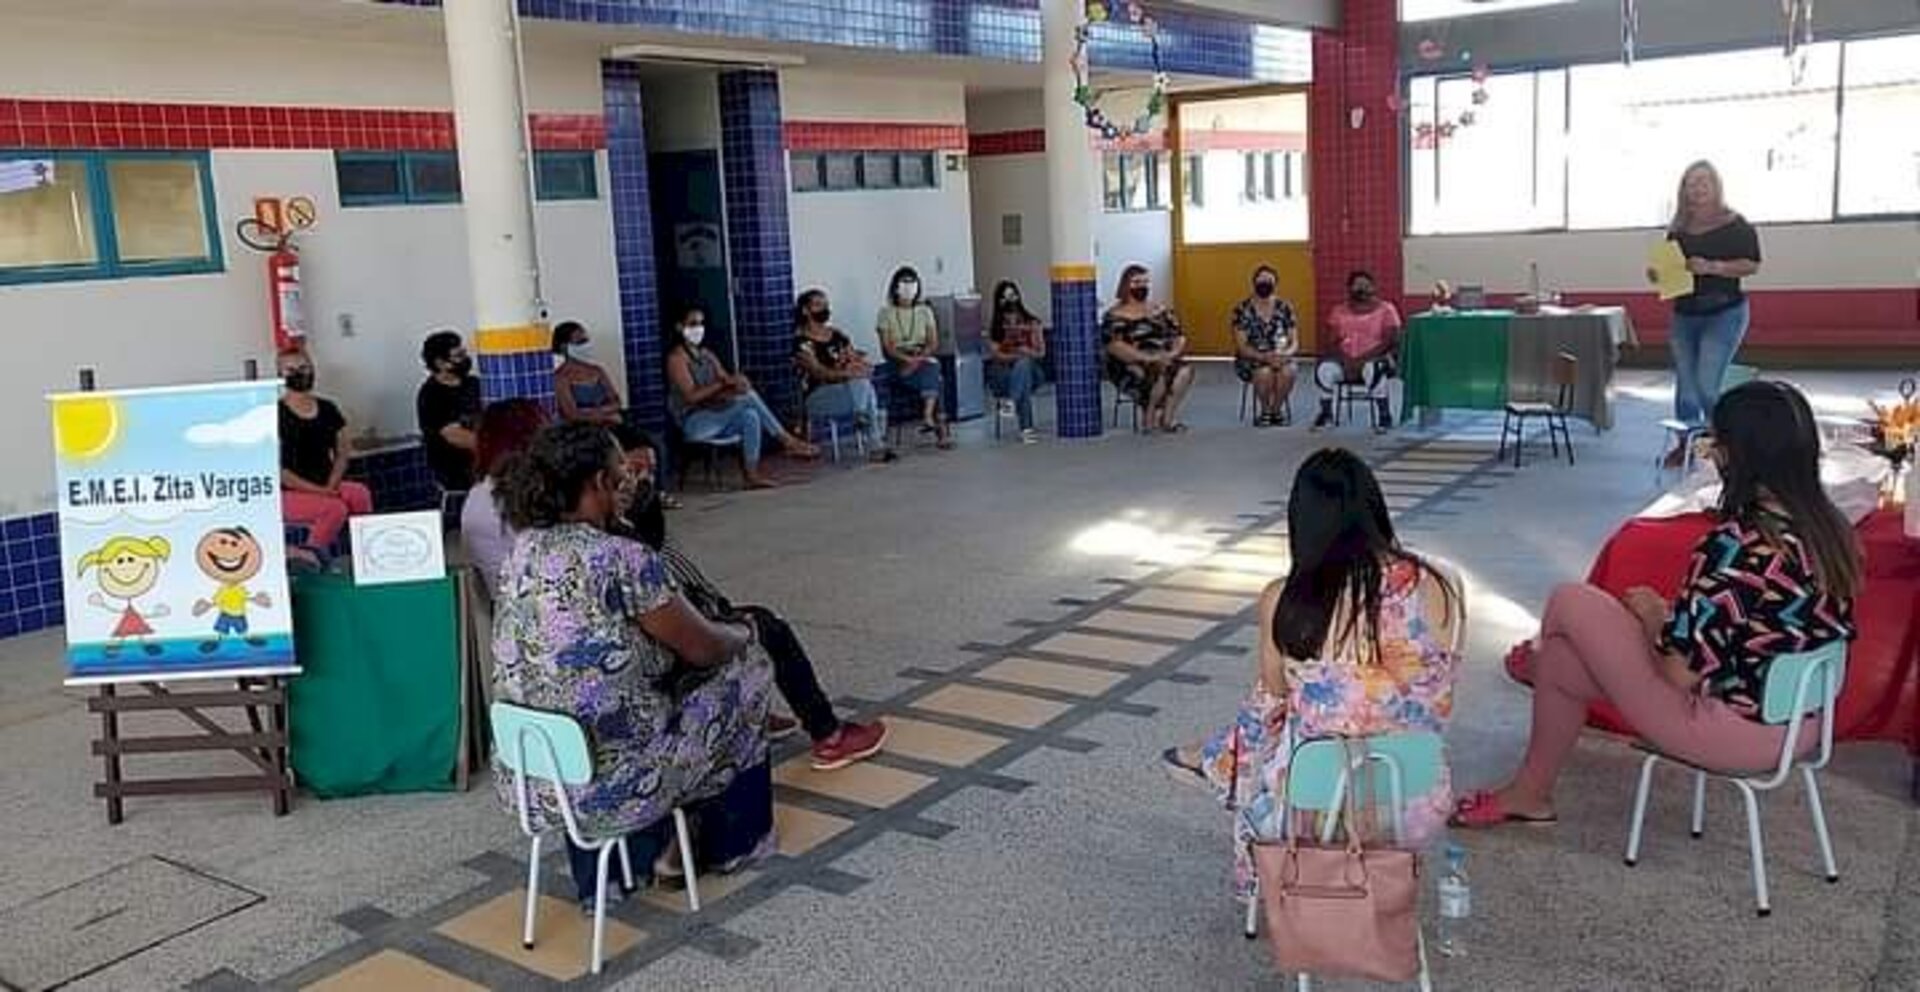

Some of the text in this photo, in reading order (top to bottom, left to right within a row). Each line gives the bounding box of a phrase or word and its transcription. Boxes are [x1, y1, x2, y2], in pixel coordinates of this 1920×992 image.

[68, 473, 273, 506] E.M.E.I. Zita Vargas
